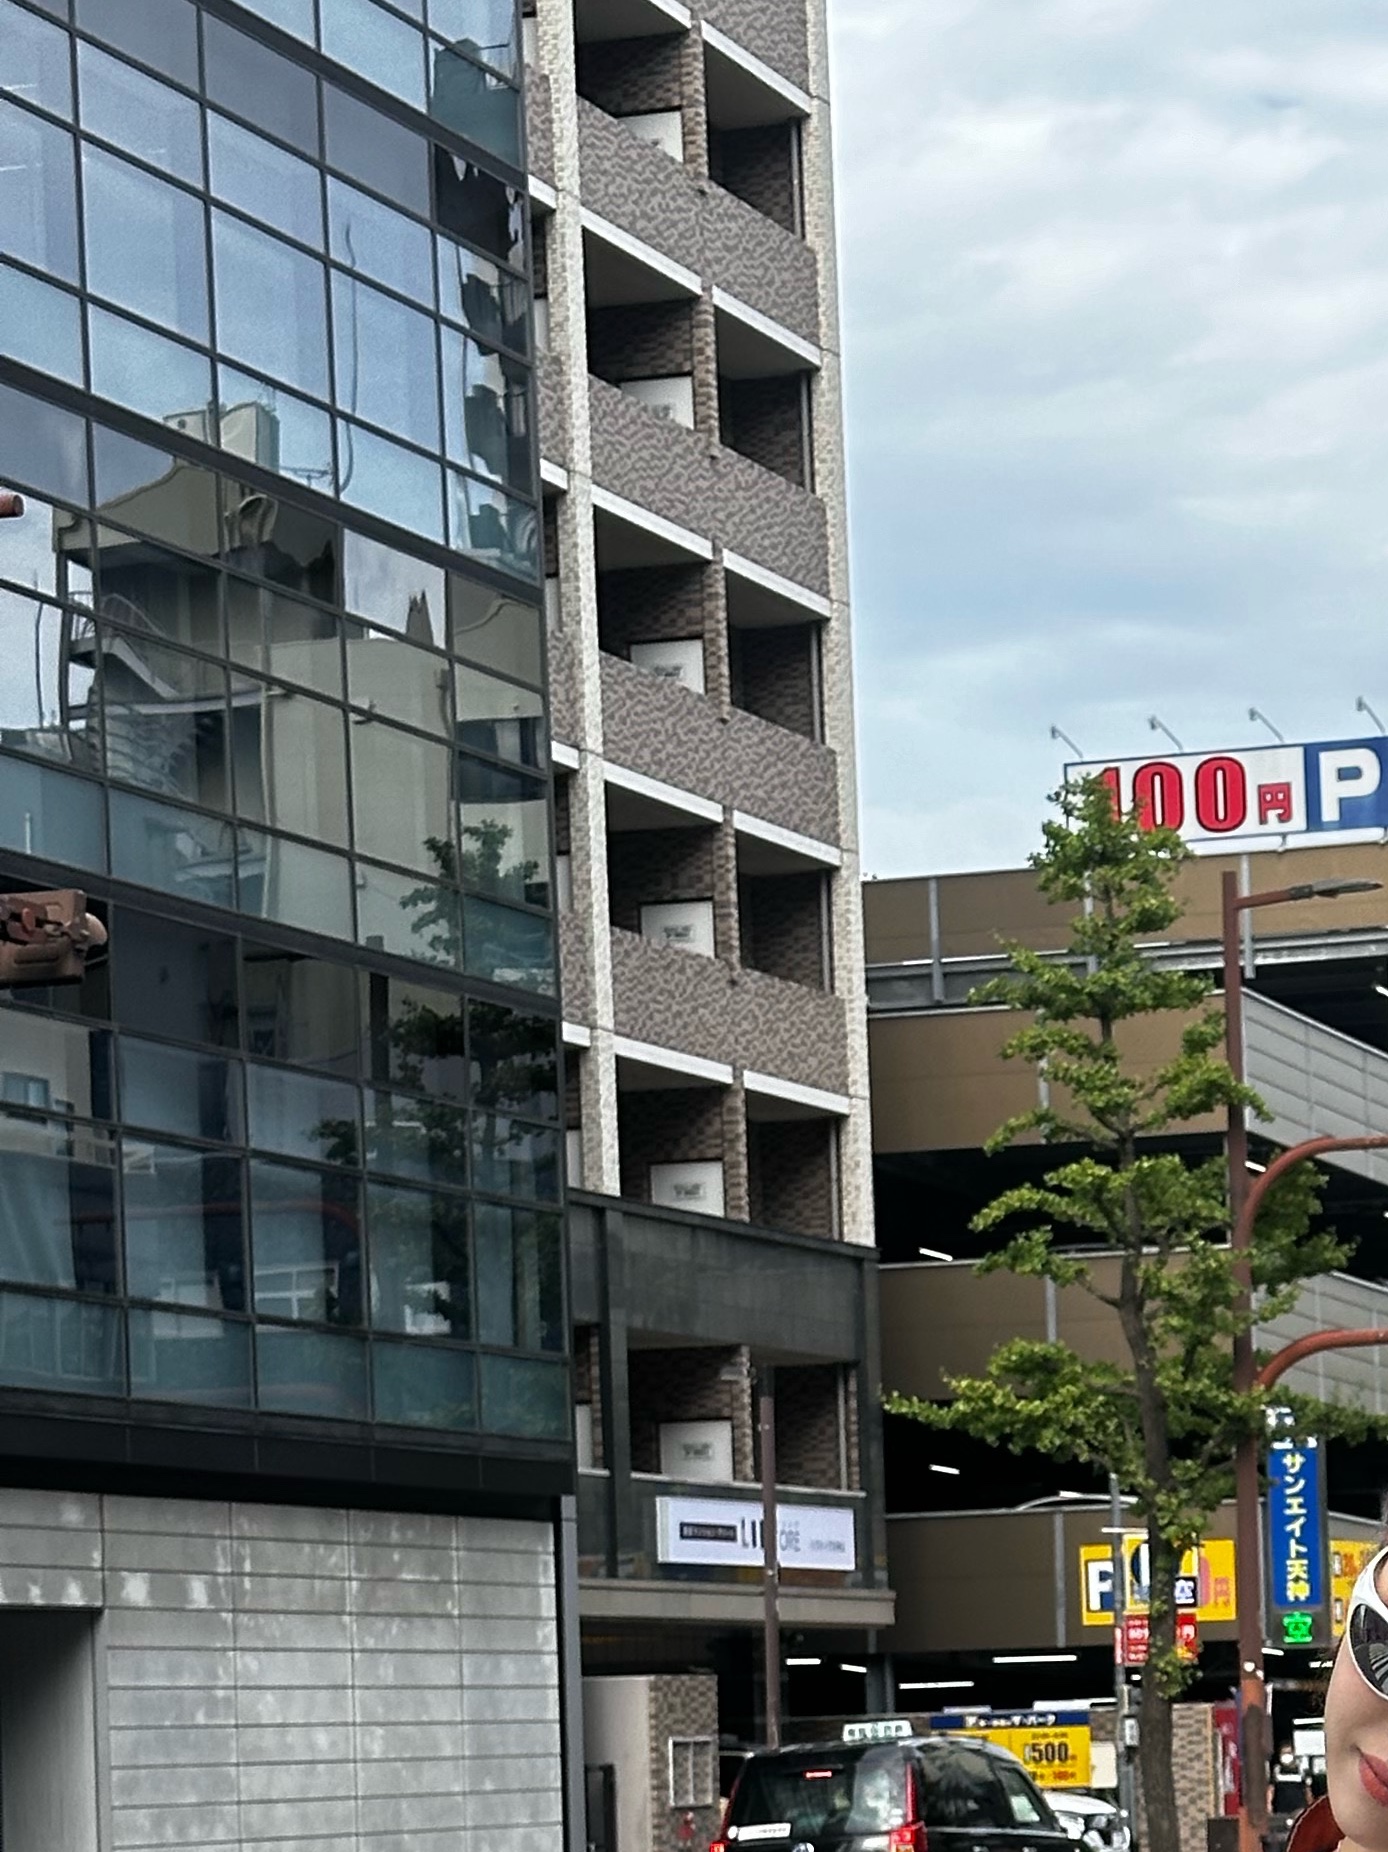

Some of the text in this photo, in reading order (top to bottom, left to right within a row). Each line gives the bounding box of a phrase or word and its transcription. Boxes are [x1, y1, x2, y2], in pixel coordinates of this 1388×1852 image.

[1318, 748, 1382, 823] P
[1282, 1452, 1311, 1602] サンエイト天神
